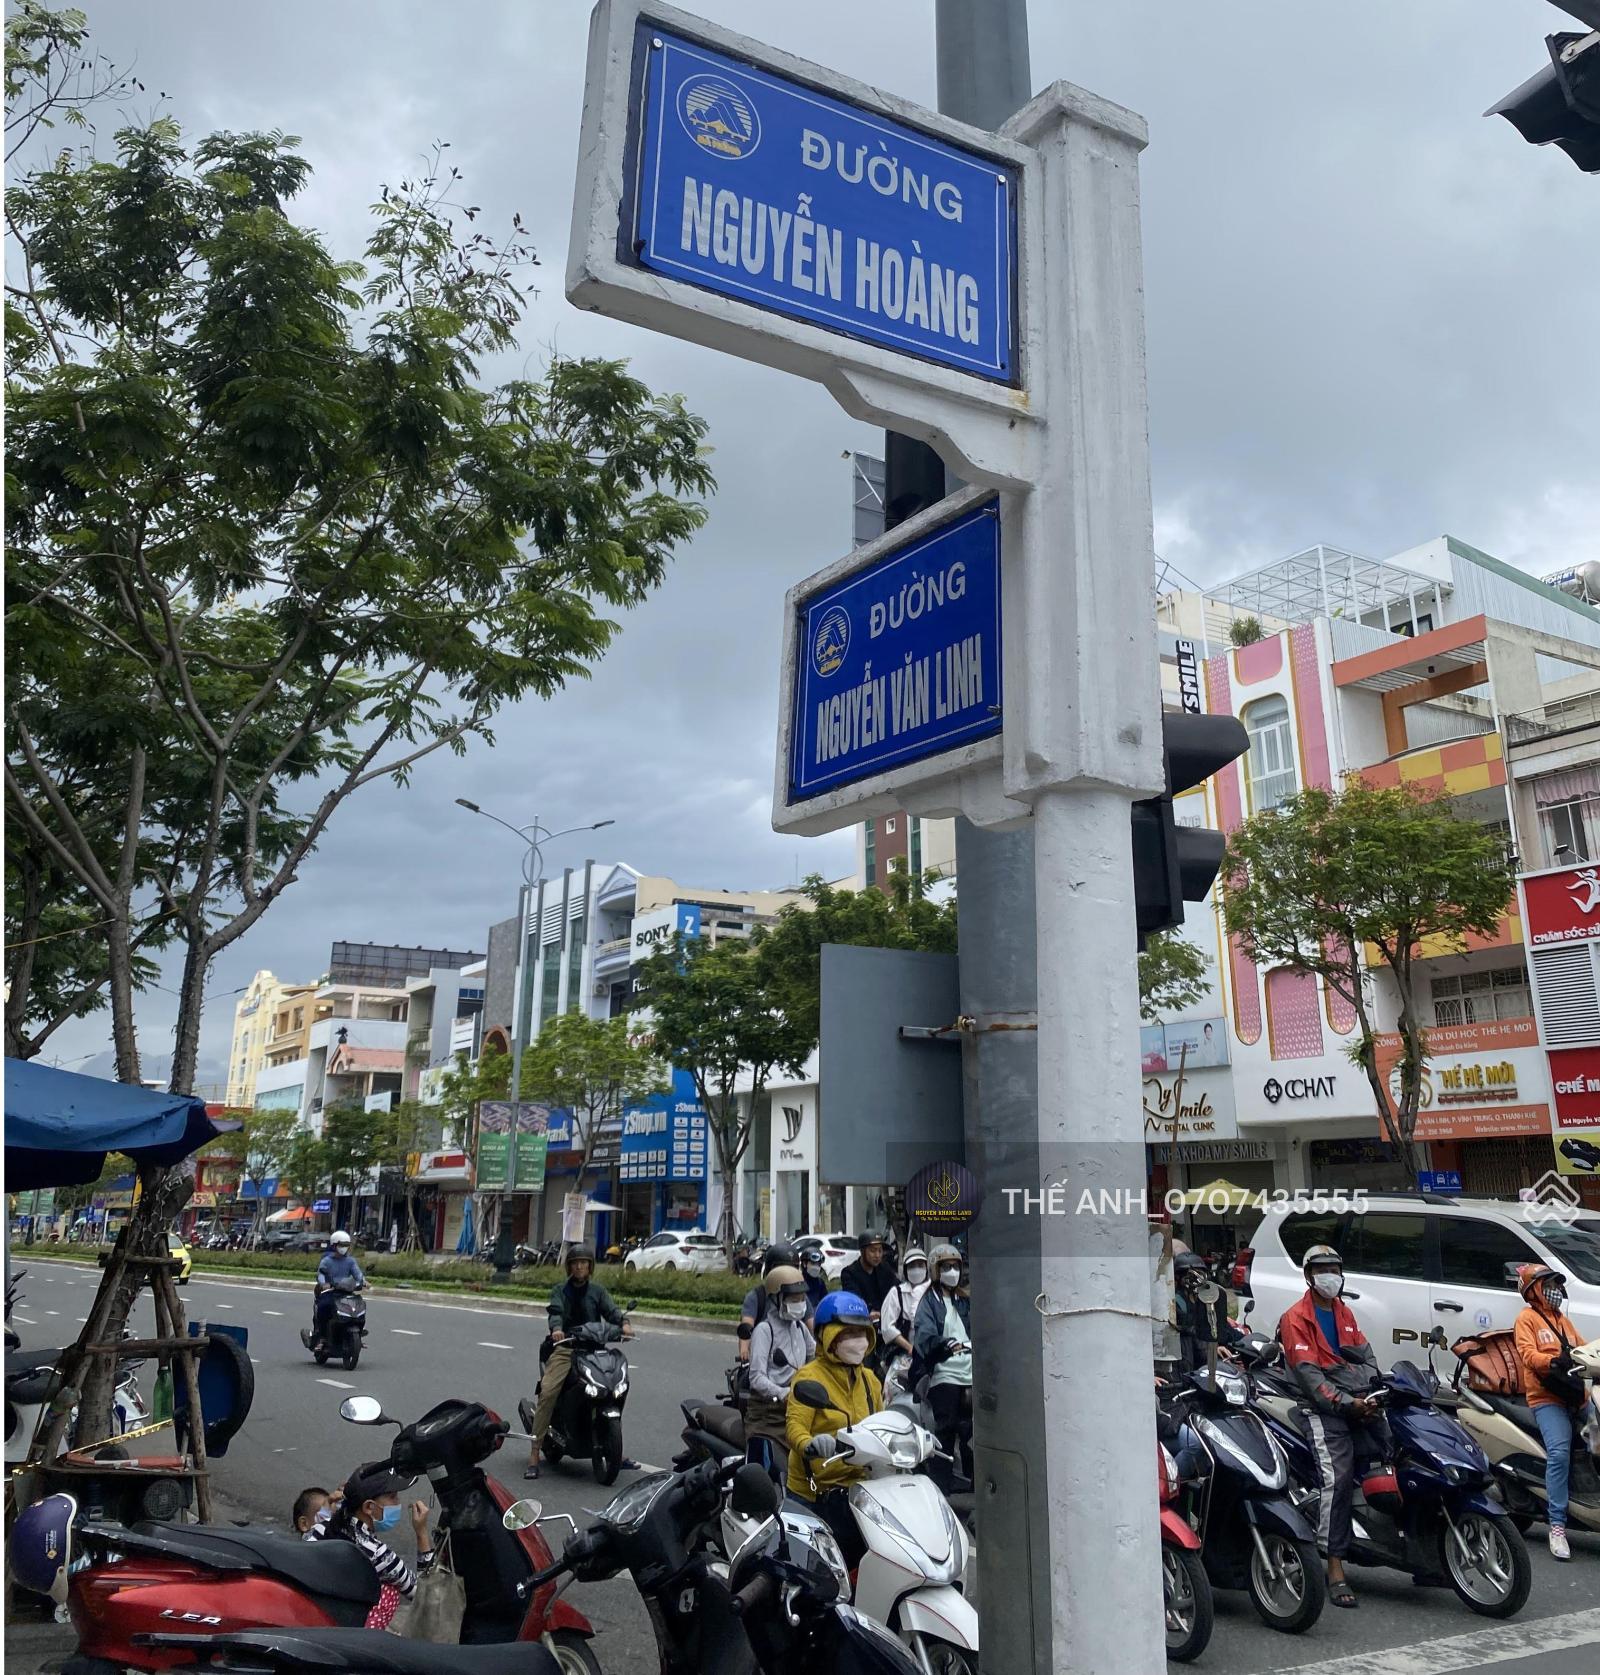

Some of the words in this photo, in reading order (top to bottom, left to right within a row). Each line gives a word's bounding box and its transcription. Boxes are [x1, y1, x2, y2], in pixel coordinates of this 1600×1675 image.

[800, 127, 964, 223] ĐƯỜNG
[681, 176, 843, 303] NGUYỄN
[856, 237, 980, 347] HOÀNG
[869, 561, 967, 640] ĐƯỜNG
[815, 660, 886, 765] NGUYỄN
[891, 651, 929, 737] VĂN
[936, 633, 983, 720] LINH
[636, 923, 670, 947] SONY
[1463, 1064, 1485, 1089] HỆ
[1485, 1061, 1516, 1085] MỚI
[1555, 1074, 1586, 1094] GHẾ
[624, 1110, 667, 1136] zShop.vn
[1193, 1121, 1215, 1131] CLINIC
[1233, 1141, 1268, 1159] SMILE
